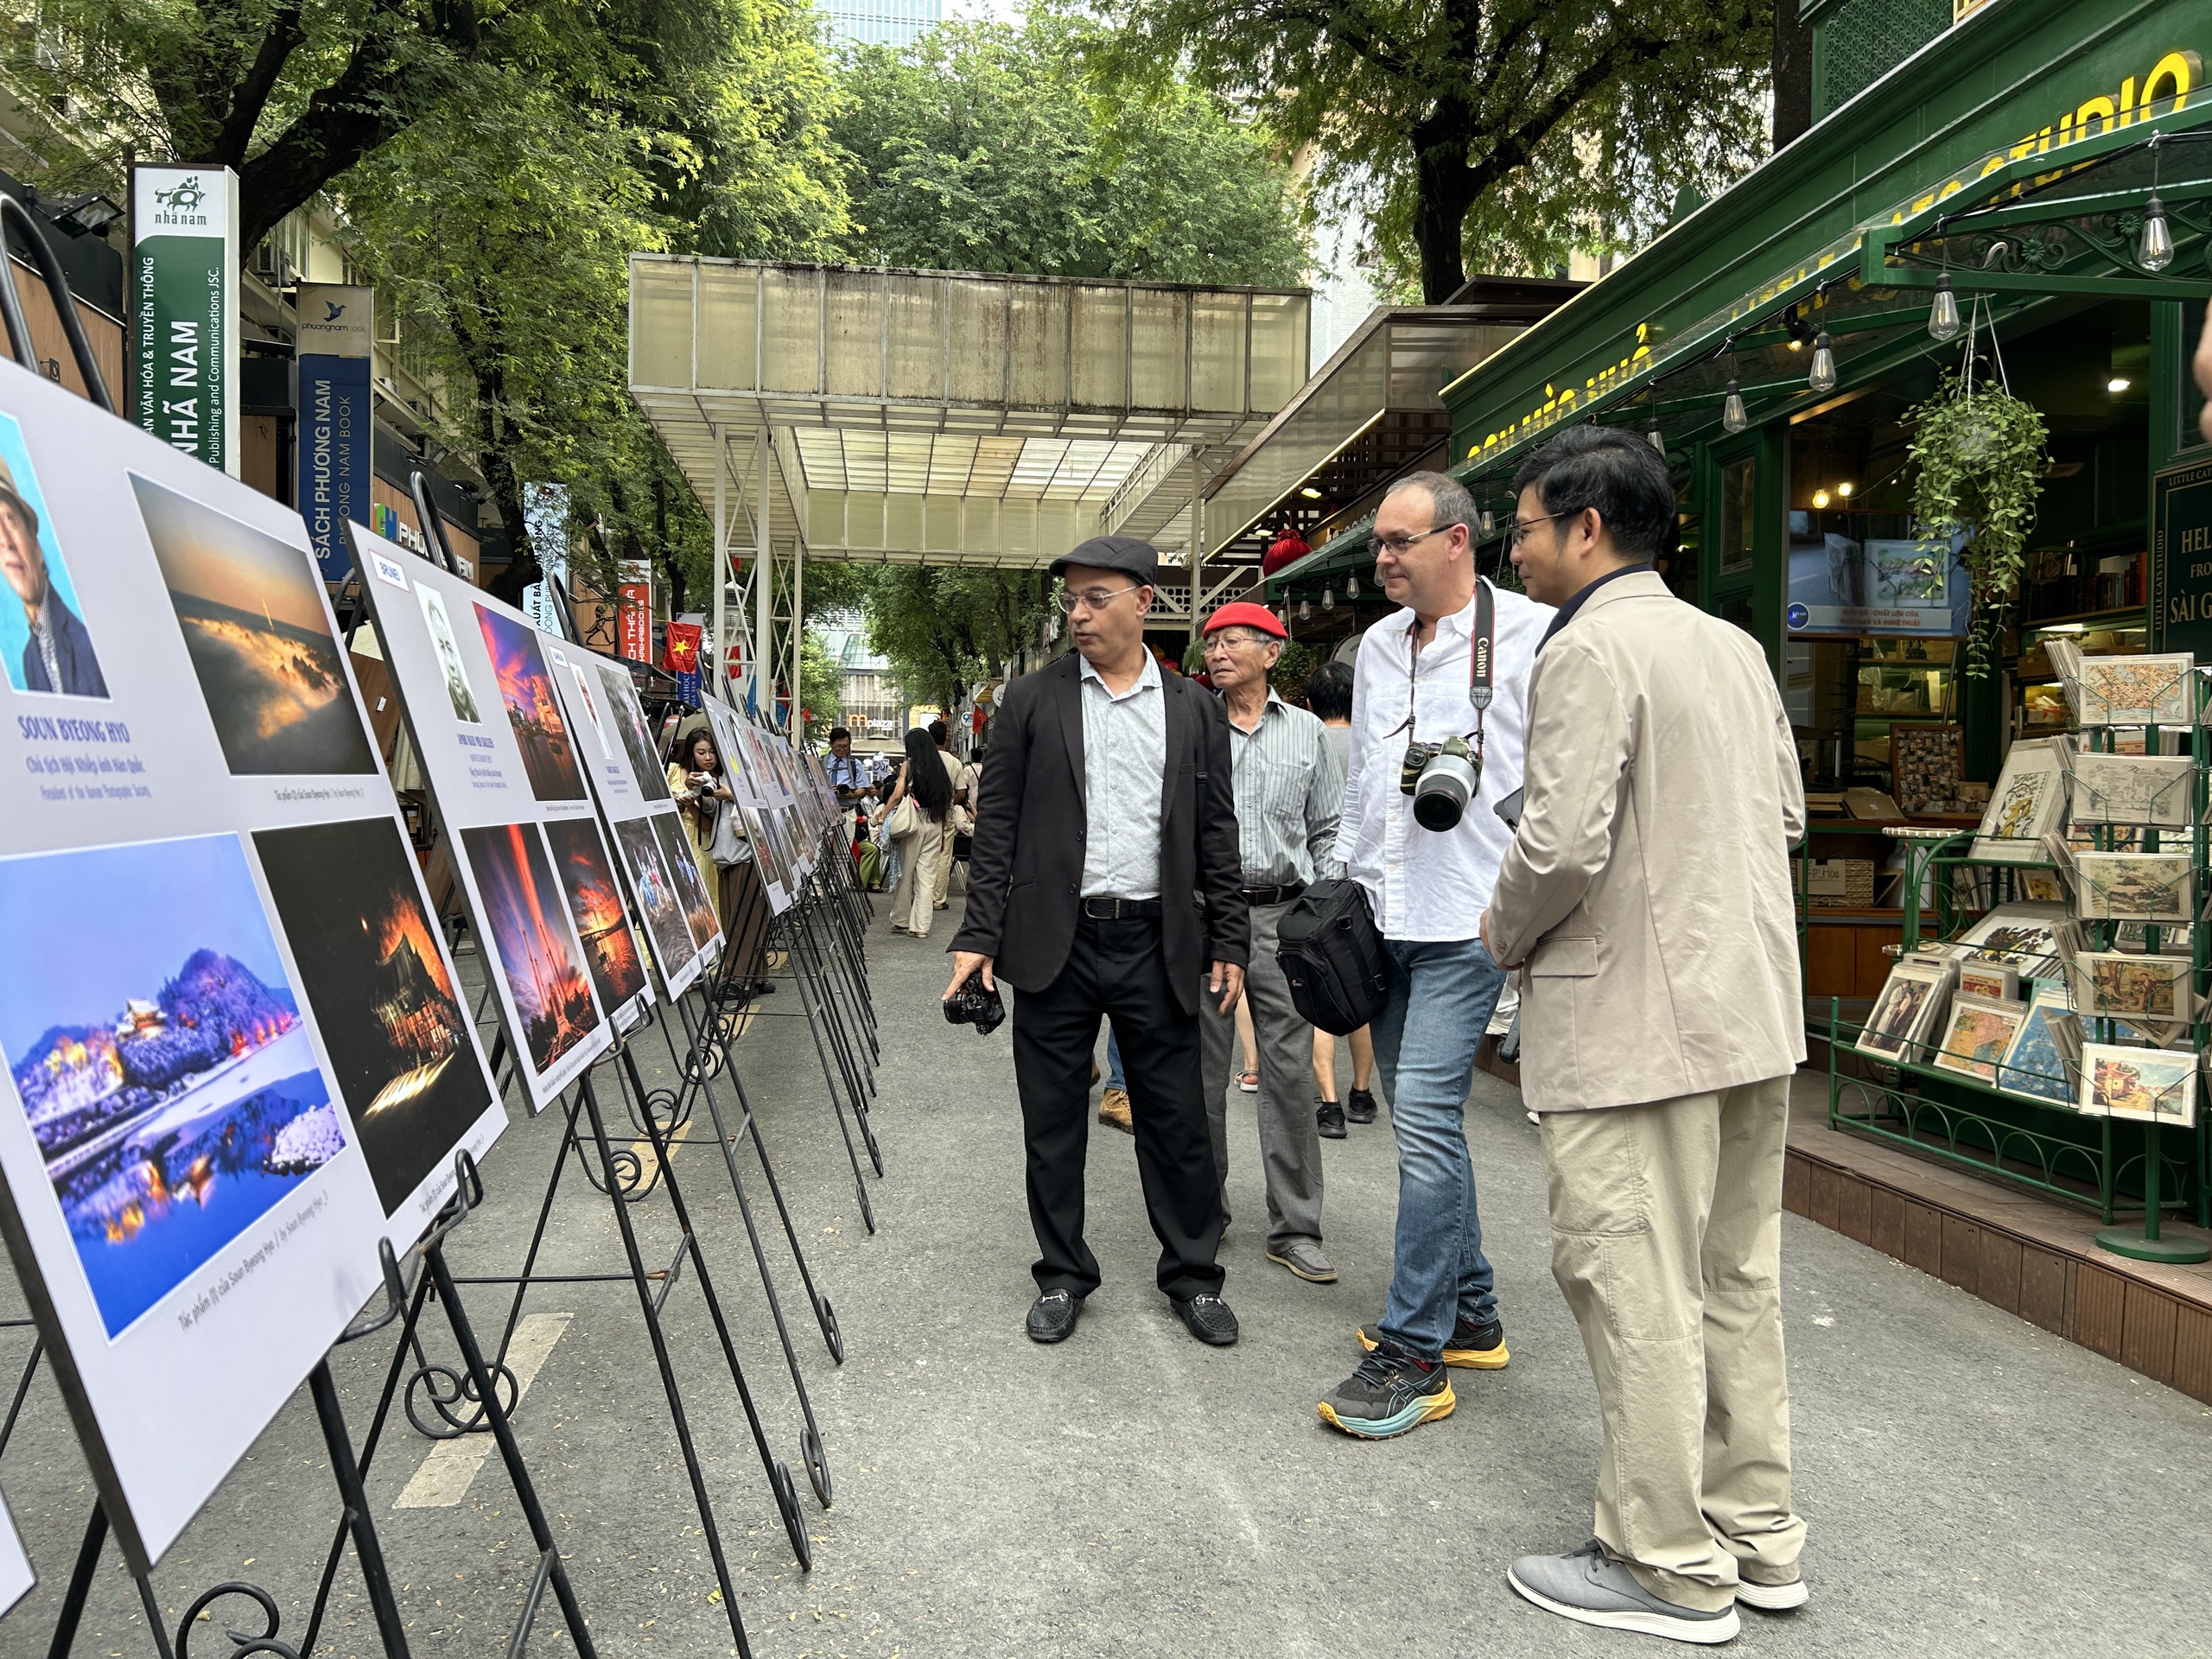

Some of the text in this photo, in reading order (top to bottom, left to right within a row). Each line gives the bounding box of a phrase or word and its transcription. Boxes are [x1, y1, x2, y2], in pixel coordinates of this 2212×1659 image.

[181, 214, 207, 226] nam
[140, 257, 154, 299] THÔNG
[138, 302, 155, 347] TRUYỀN
[143, 349, 154, 359] &
[207, 267, 222, 463] Publishing and Communications JSC.
[140, 362, 154, 387] HÓA
[162, 321, 199, 456] NHÃ NAM
[140, 391, 154, 415] VĂN
[339, 396, 351, 437] BOOK
[311, 379, 331, 559] SÁCH PHƯƠNG NAM
[339, 443, 350, 476] NAM
[2169, 467, 2212, 486] LITTLE CAT
[2156, 530, 2164, 569] STUDIO
[2180, 525, 2212, 554] HEL
[2170, 588, 2196, 624] SÀI
[1476, 637, 1490, 677] Canon
[17, 715, 130, 743] SOUN BYEONG HYO
